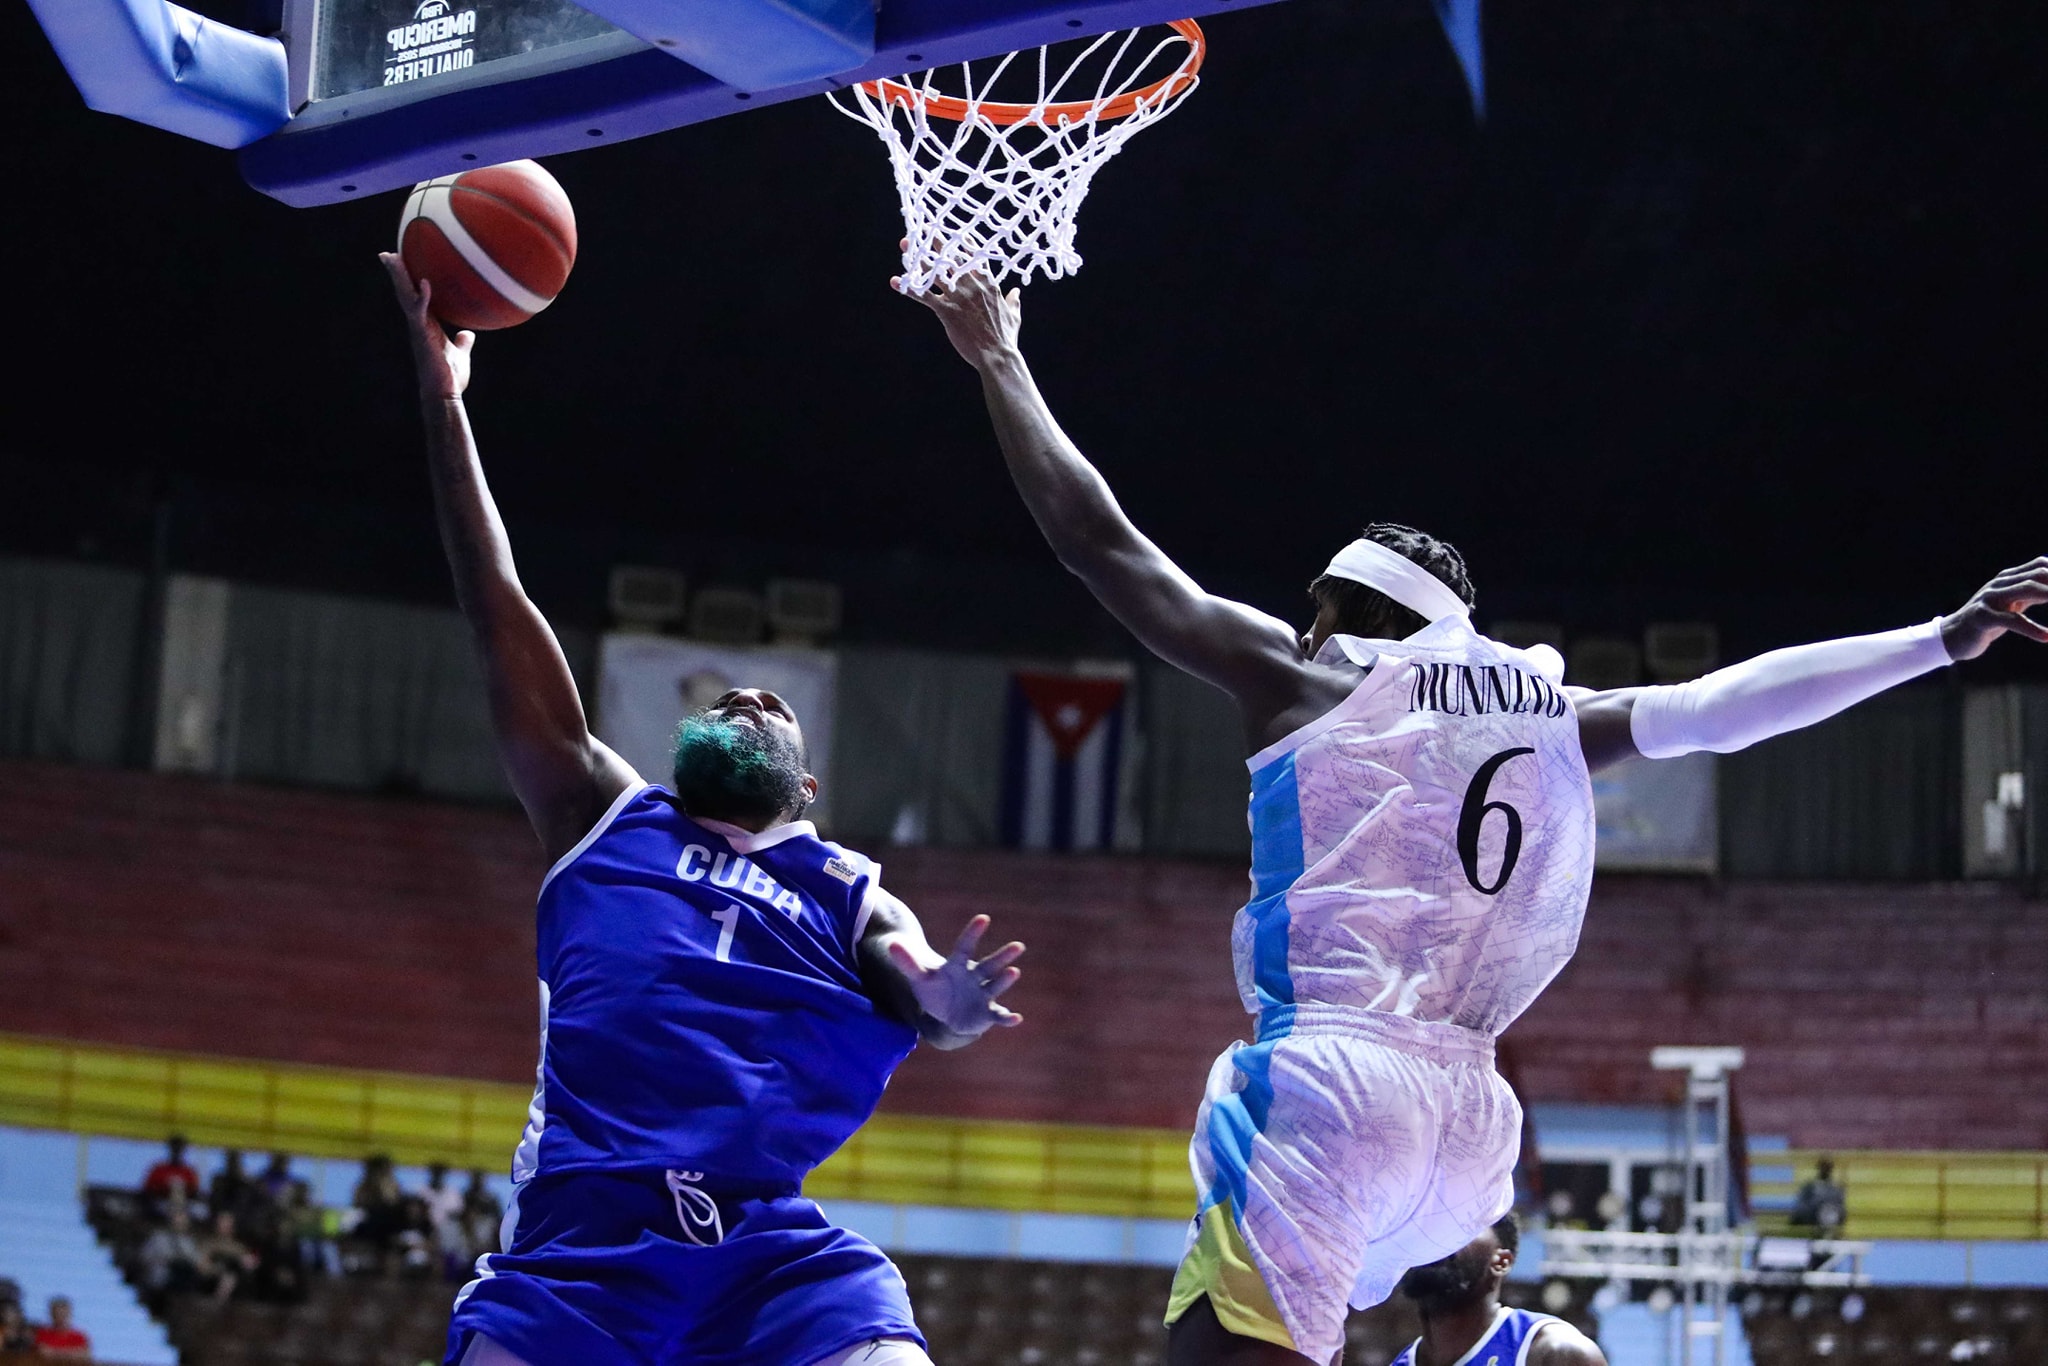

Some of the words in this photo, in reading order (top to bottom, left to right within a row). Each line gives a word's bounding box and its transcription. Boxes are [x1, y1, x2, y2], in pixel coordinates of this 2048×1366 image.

[1456, 746, 1536, 896] 6
[676, 843, 803, 924] CUBA
[710, 903, 741, 964] 1
